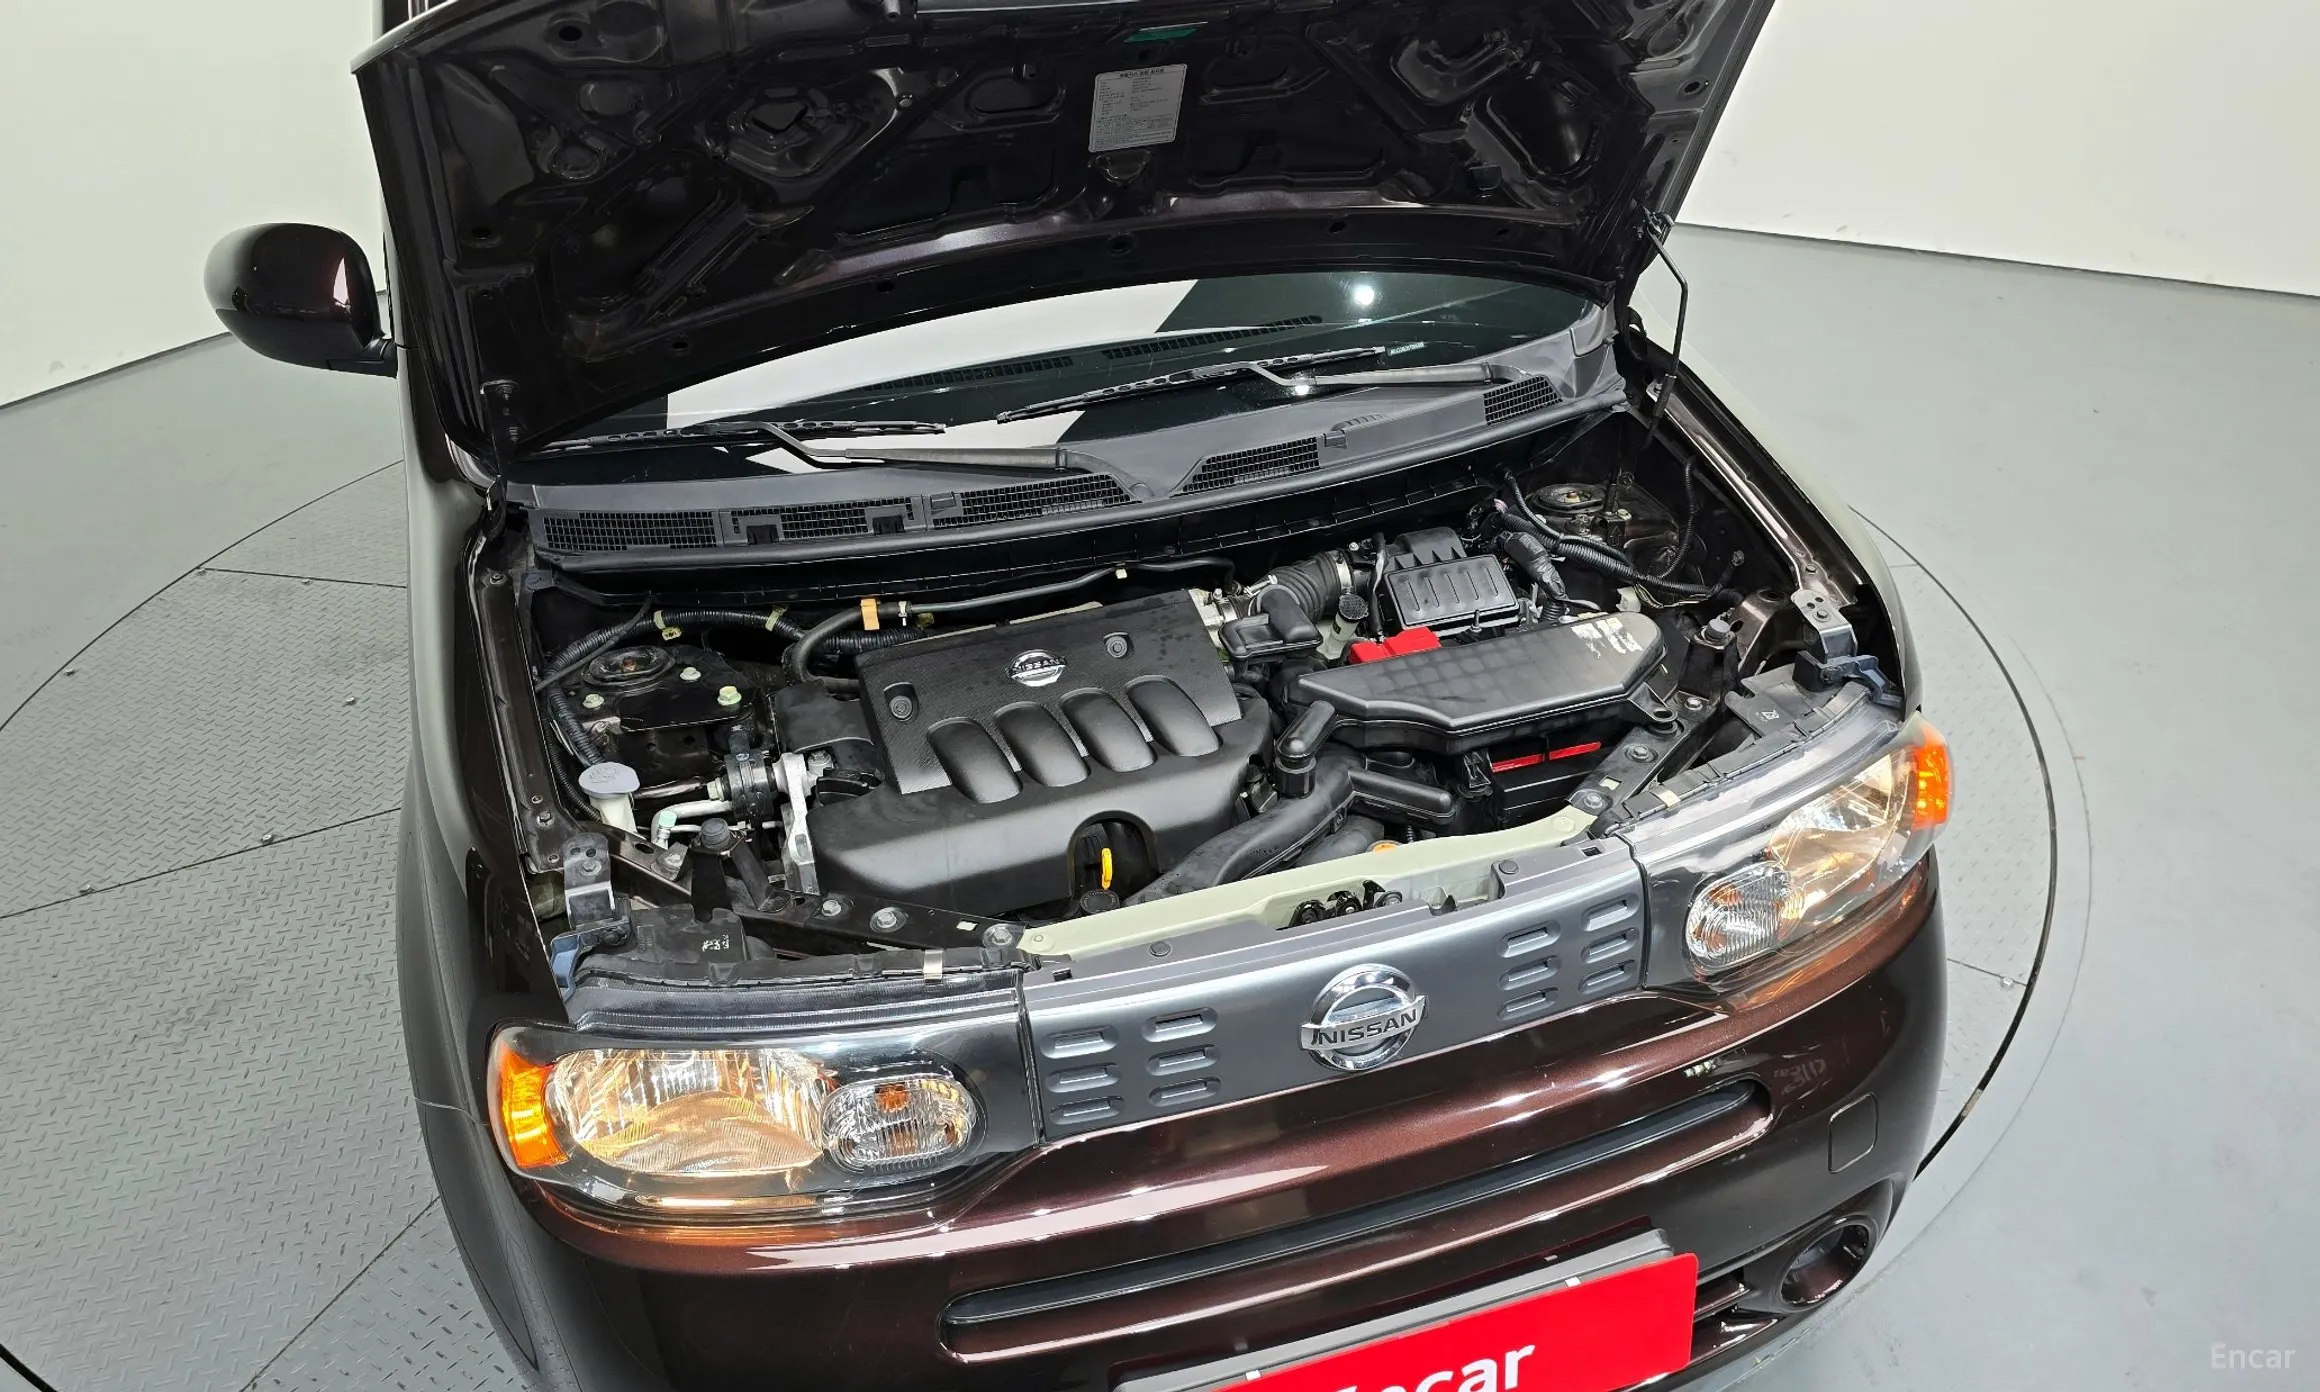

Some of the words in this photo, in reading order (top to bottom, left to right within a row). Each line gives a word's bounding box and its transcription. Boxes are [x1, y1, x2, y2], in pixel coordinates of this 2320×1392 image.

[1012, 657, 1060, 675] NISSAN
[1316, 1008, 1417, 1046] NISSAN
[1333, 1344, 1536, 1392] car
